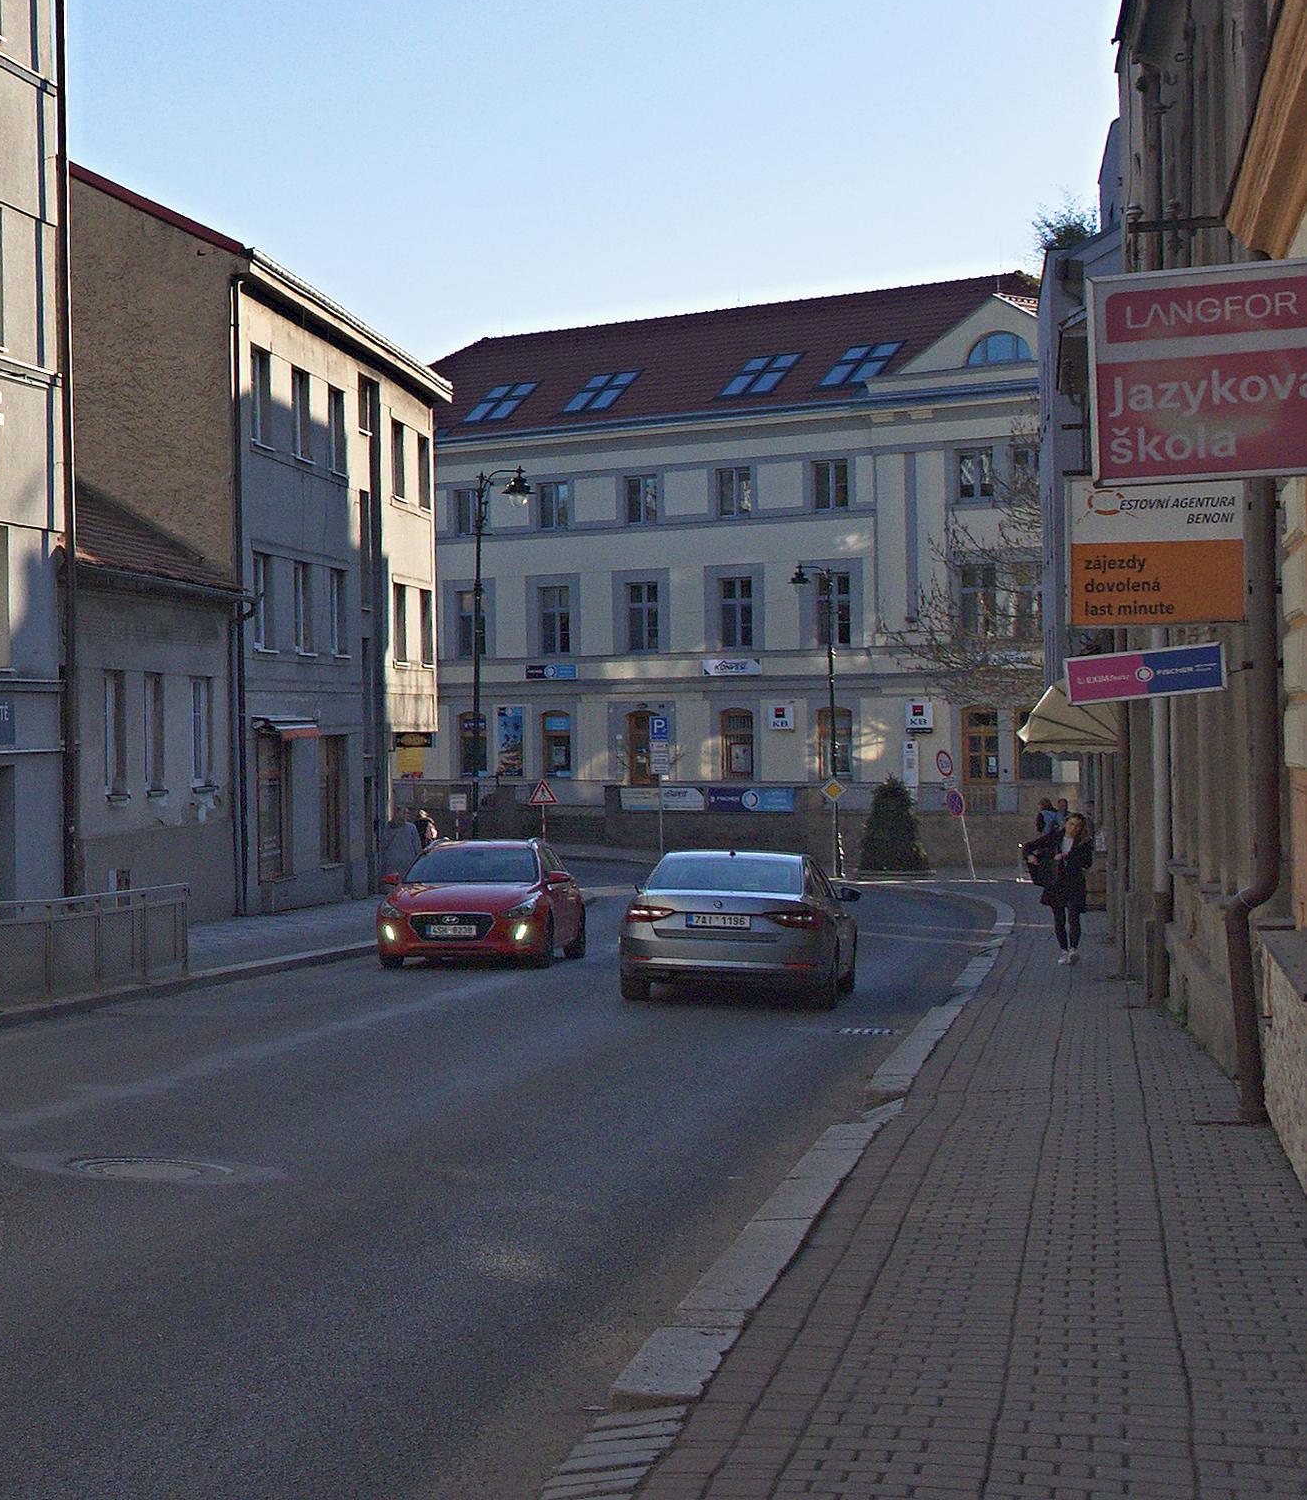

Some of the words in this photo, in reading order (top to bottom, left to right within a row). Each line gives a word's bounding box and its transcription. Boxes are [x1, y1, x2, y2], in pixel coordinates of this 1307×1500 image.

[1125, 291, 1298, 330] LANGFOR
[1109, 422, 1238, 465] škola
[1172, 496, 1236, 510] AGENTURA
[1186, 512, 1235, 525] BENONI
[1085, 555, 1146, 574] zájezdy
[1085, 578, 1161, 593] dovolená
[1085, 601, 1113, 616] last
[1117, 601, 1175, 615] minute
[653, 719, 665, 734] P
[772, 720, 789, 728] KB
[909, 718, 928, 726] KB
